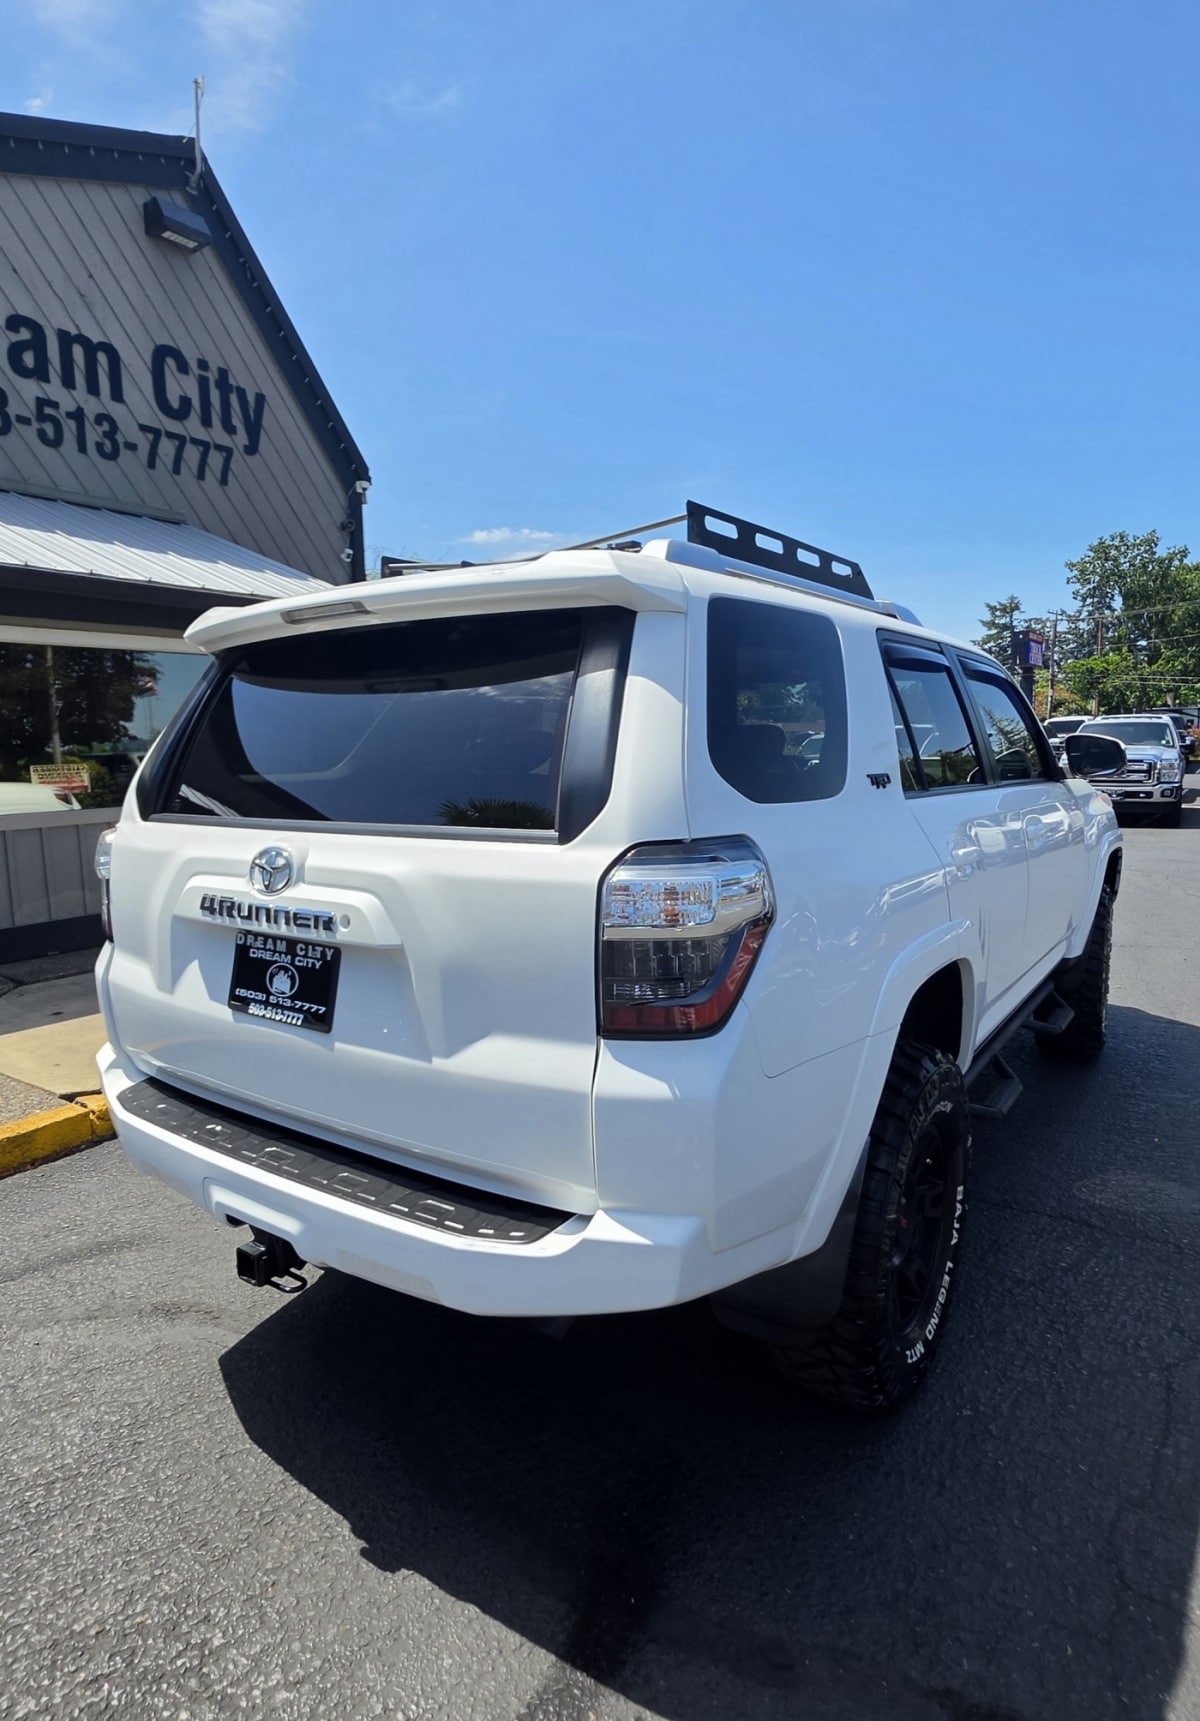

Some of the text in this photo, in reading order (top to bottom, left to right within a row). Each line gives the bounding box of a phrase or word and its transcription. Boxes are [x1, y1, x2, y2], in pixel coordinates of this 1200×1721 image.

[151, 343, 266, 456] City
[236, 933, 334, 961] DREAM CITY
[249, 948, 322, 969] DREAM CITY
[235, 987, 267, 1001] (503)
[950, 1185, 964, 1246] BAJA
[925, 1260, 954, 1341] LEGEND
